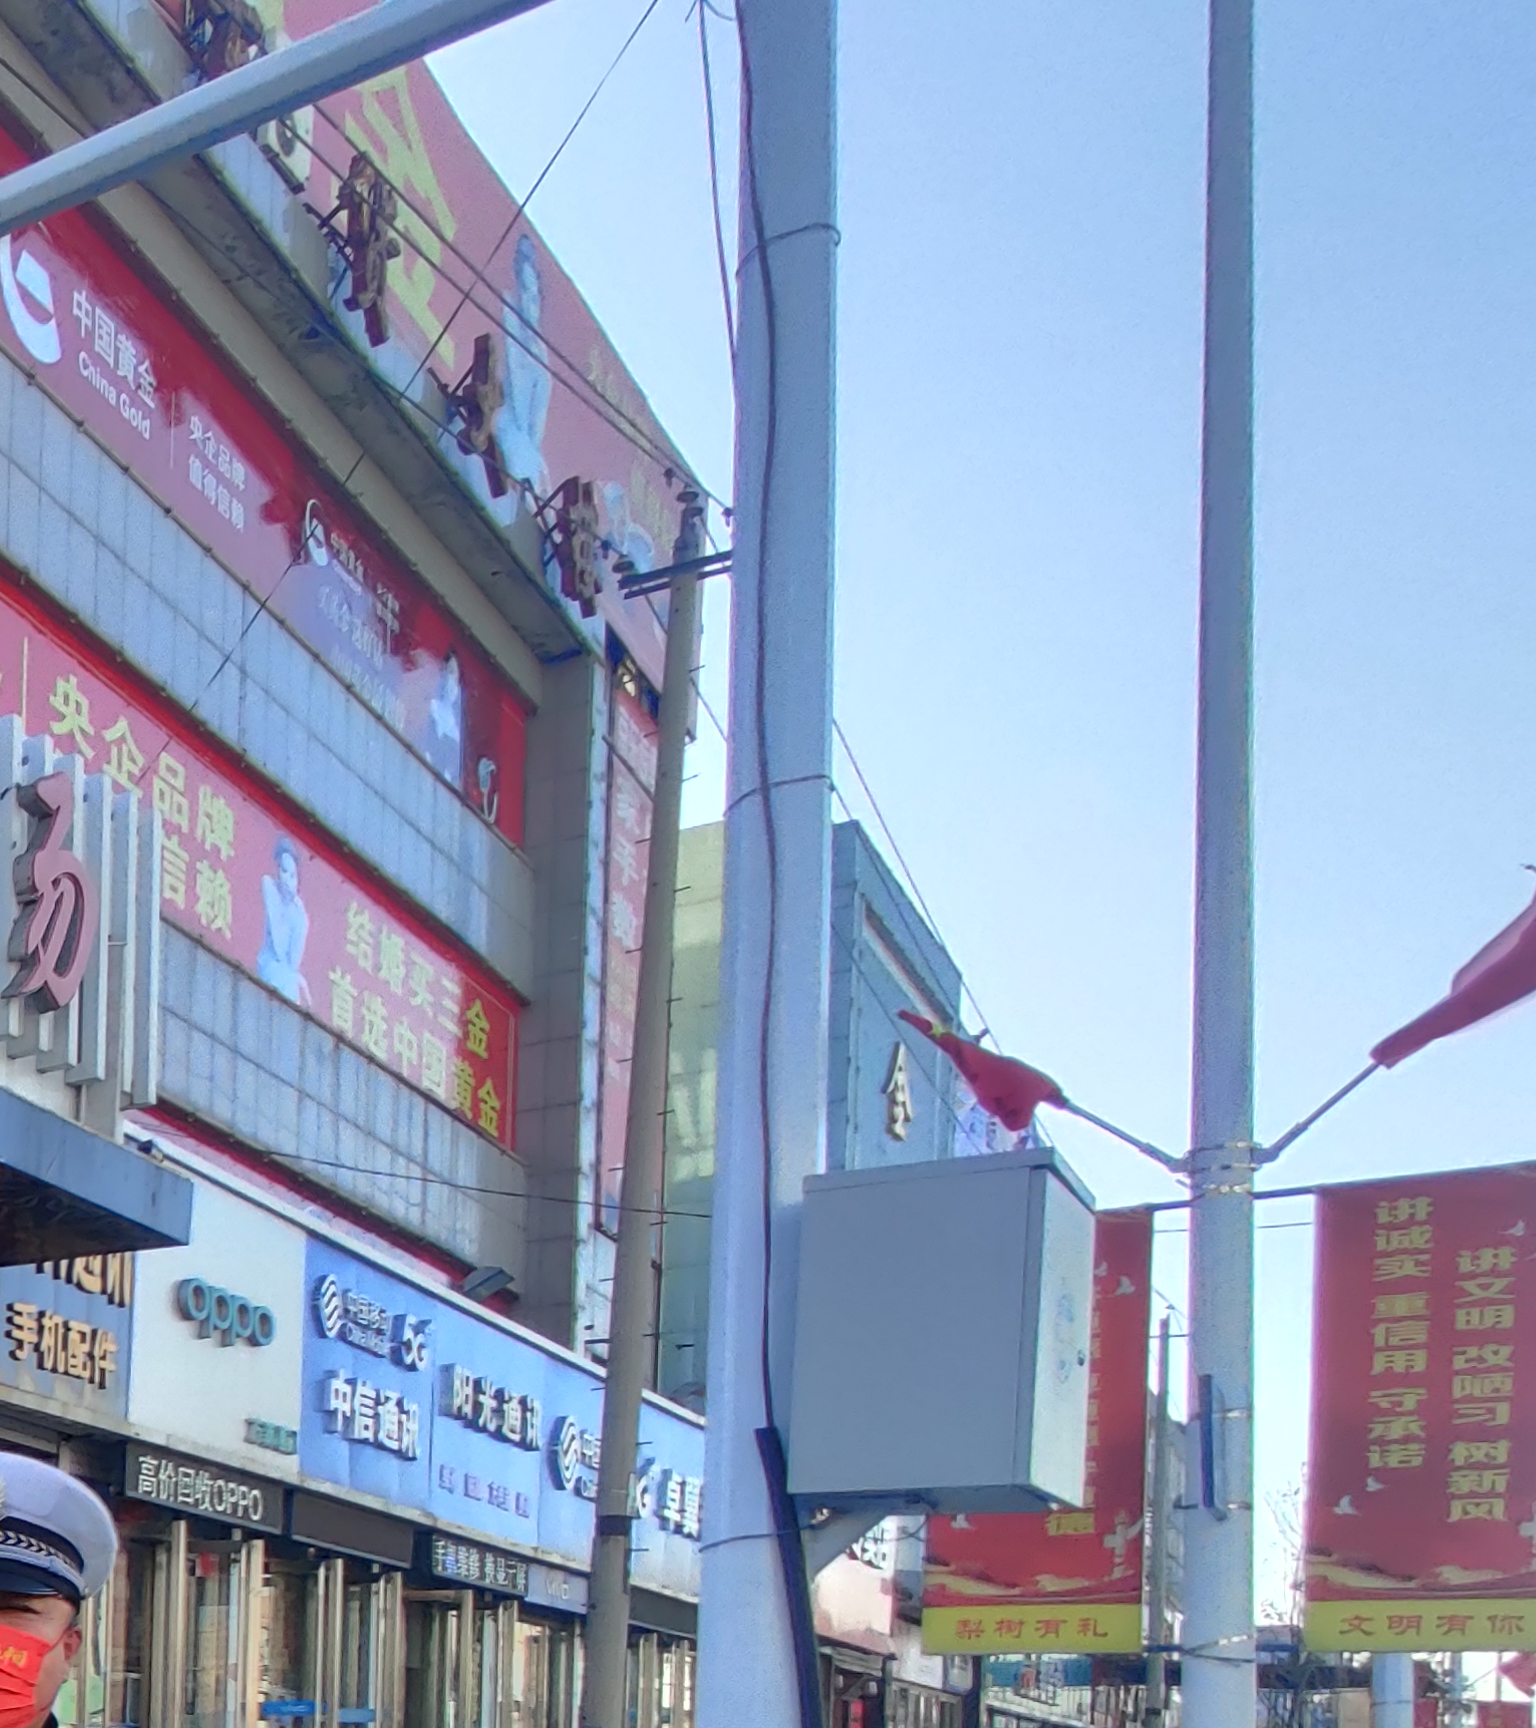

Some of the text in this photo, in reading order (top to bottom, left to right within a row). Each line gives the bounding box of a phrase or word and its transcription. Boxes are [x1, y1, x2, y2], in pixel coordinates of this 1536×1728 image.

[72, 290, 158, 410] 中国黄金
[79, 351, 151, 441] China Gold
[7, 1301, 120, 1389] 手机配件
[176, 1276, 277, 1347] oppo
[1366, 1197, 1435, 1470] 讲诚实 重信用 守承诺
[328, 1369, 419, 1461] 中信通讯
[451, 1362, 542, 1451] 阳光通讯
[1446, 1247, 1518, 1523] 讲文明 改陋习 树新风
[137, 1454, 264, 1522] 高价回收OPPO
[955, 1617, 1109, 1641] 梨树有礼
[1339, 1612, 1526, 1637] 文明有你
